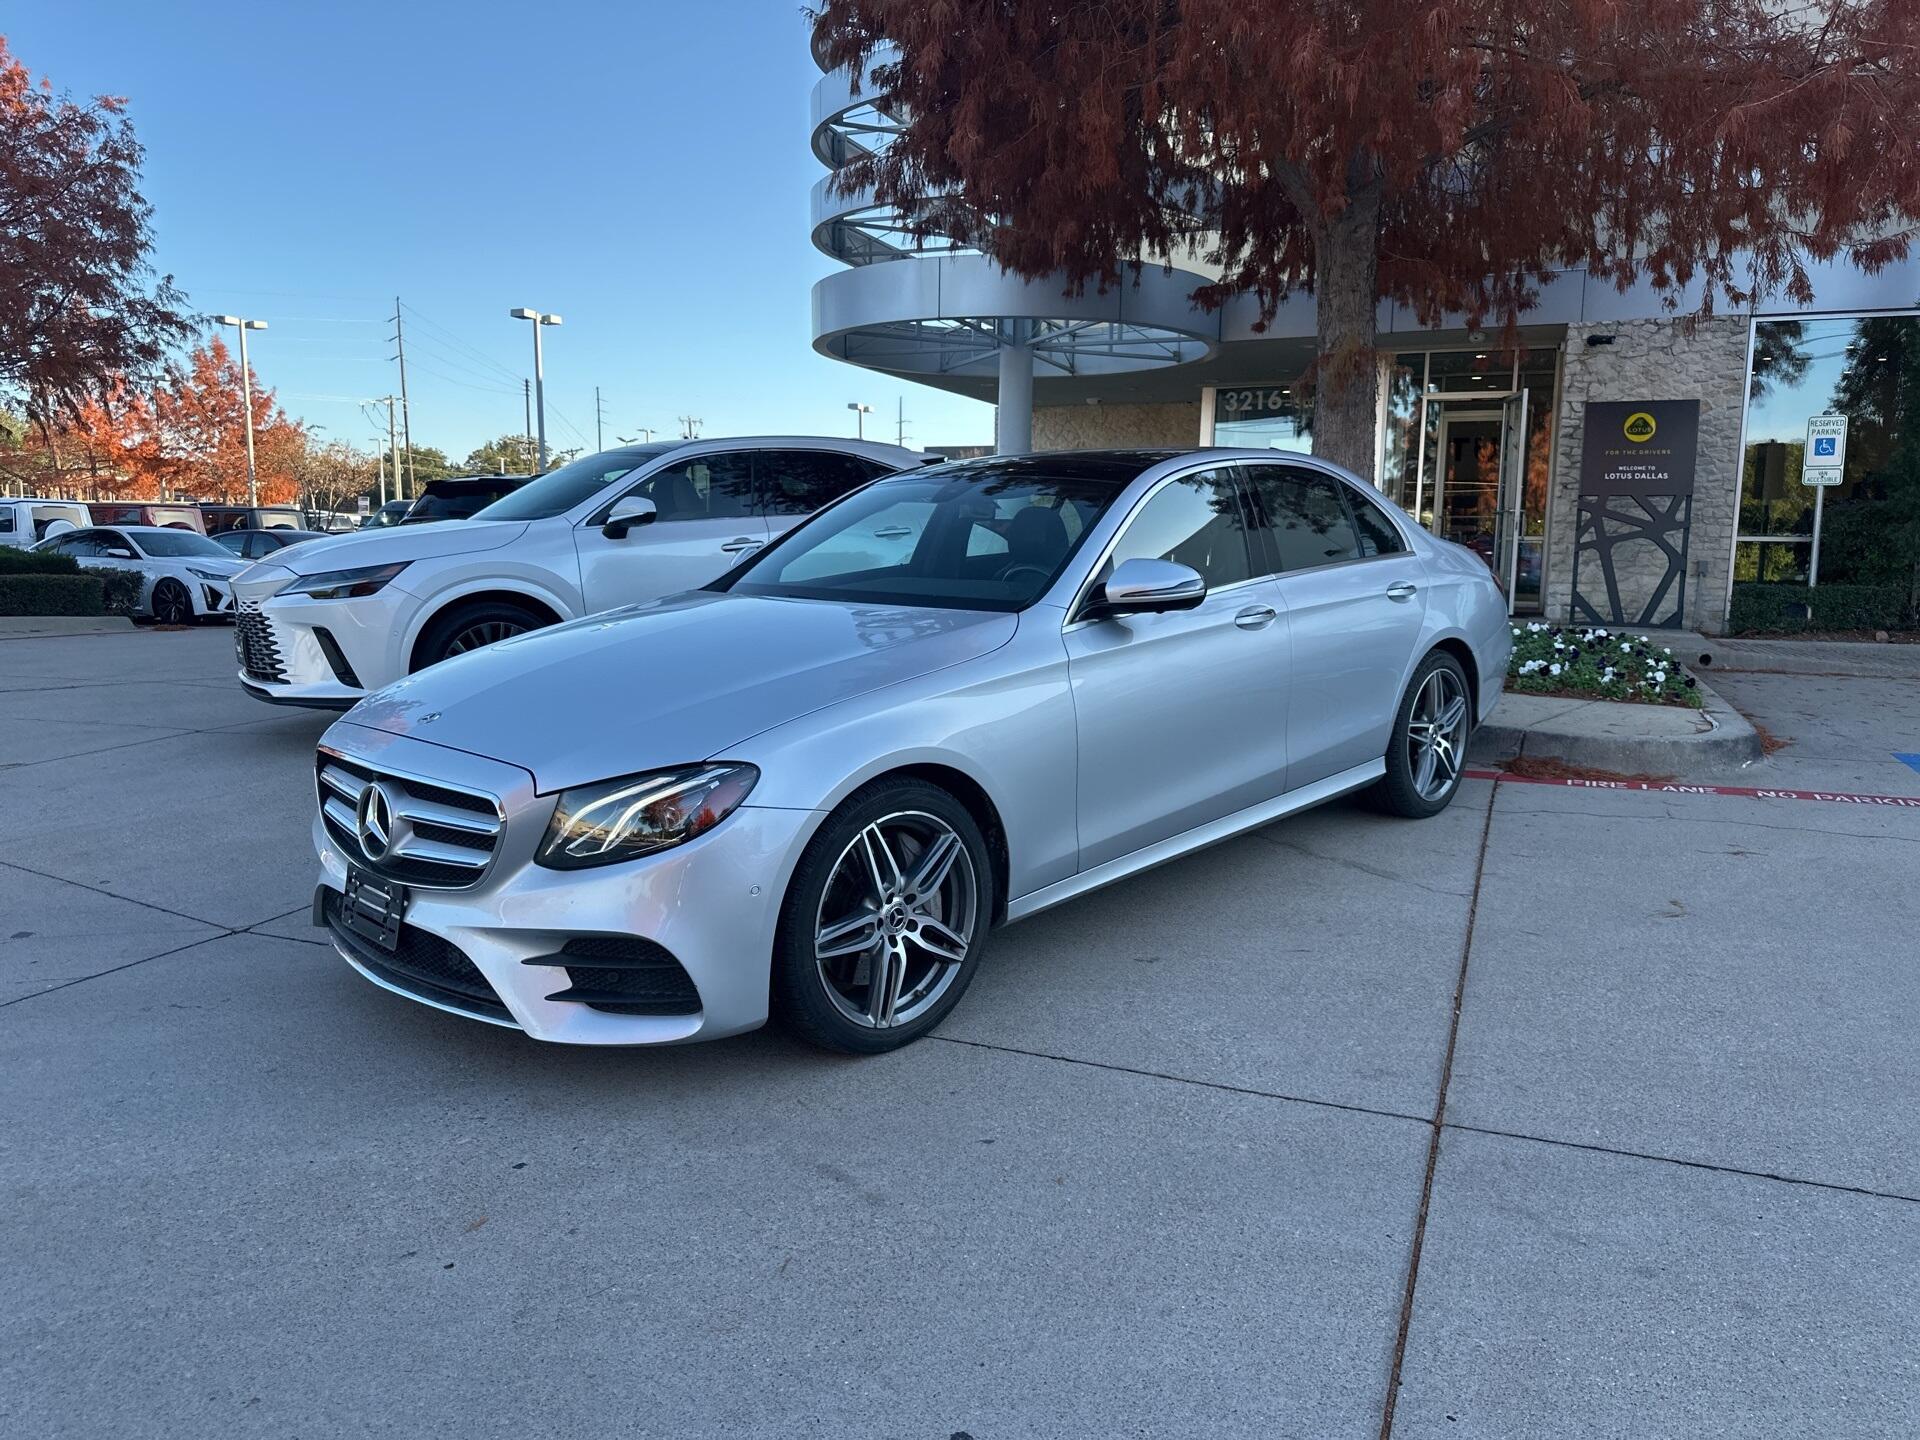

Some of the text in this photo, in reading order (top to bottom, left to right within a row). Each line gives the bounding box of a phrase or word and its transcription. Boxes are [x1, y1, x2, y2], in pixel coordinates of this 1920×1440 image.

[1810, 419, 1845, 427] RESERVED
[1811, 428, 1842, 436] PARKING
[1634, 472, 1669, 480] DALLAS
[1567, 779, 1628, 788] FIRE
[1641, 783, 1718, 794] LANE
[1756, 790, 1798, 799] NO
